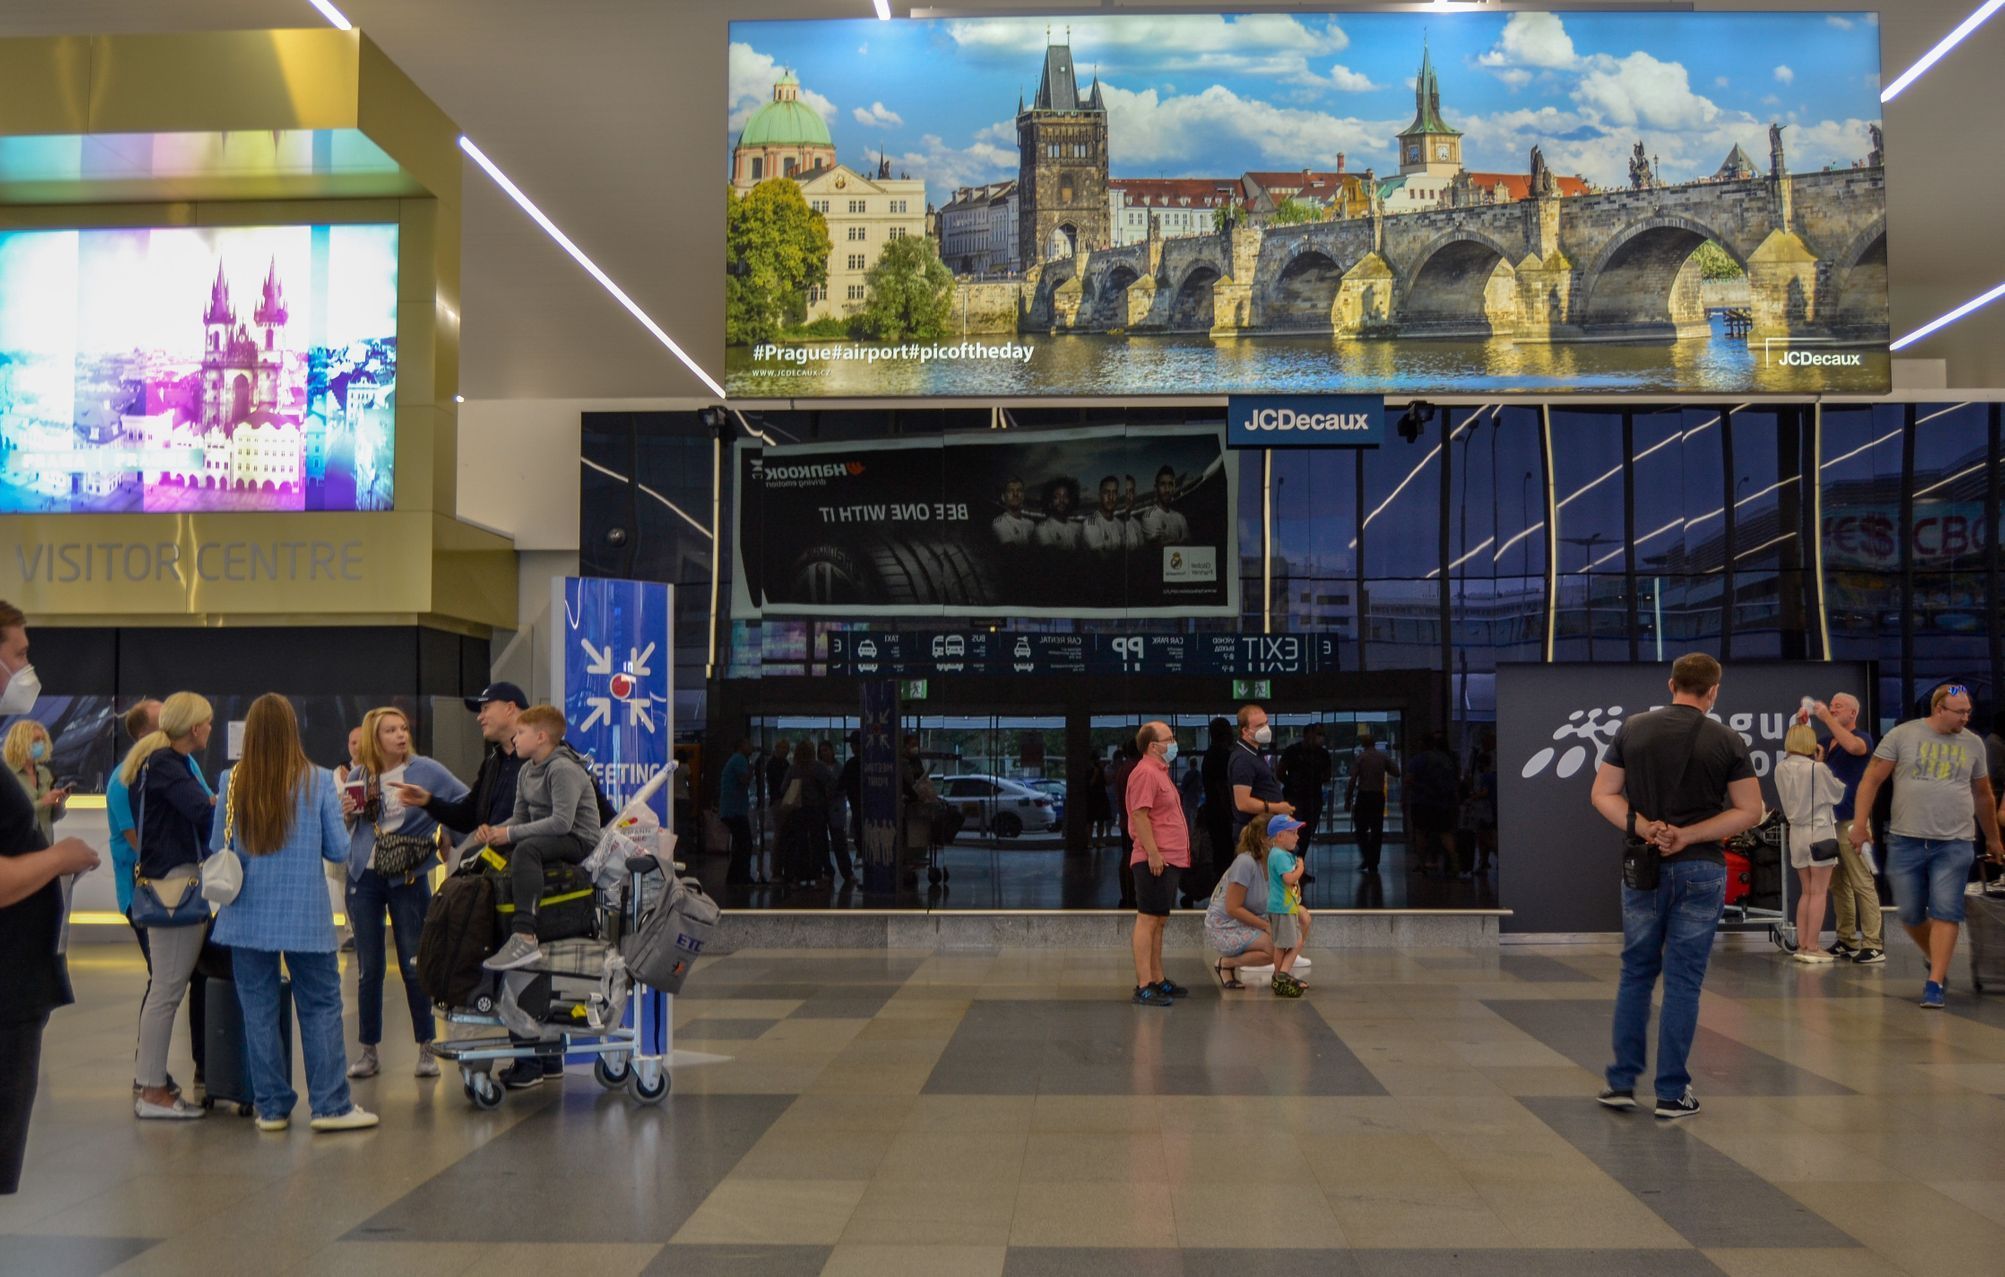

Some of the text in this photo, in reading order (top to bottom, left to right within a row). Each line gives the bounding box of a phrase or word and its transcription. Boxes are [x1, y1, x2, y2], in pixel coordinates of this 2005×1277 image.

[752, 342, 1035, 364] #Prague#airport#picoftheday
[1778, 351, 1861, 366] JCDecaux
[1244, 408, 1369, 431] JCDecaux
[14, 541, 364, 582] VISITOR CENTRE
